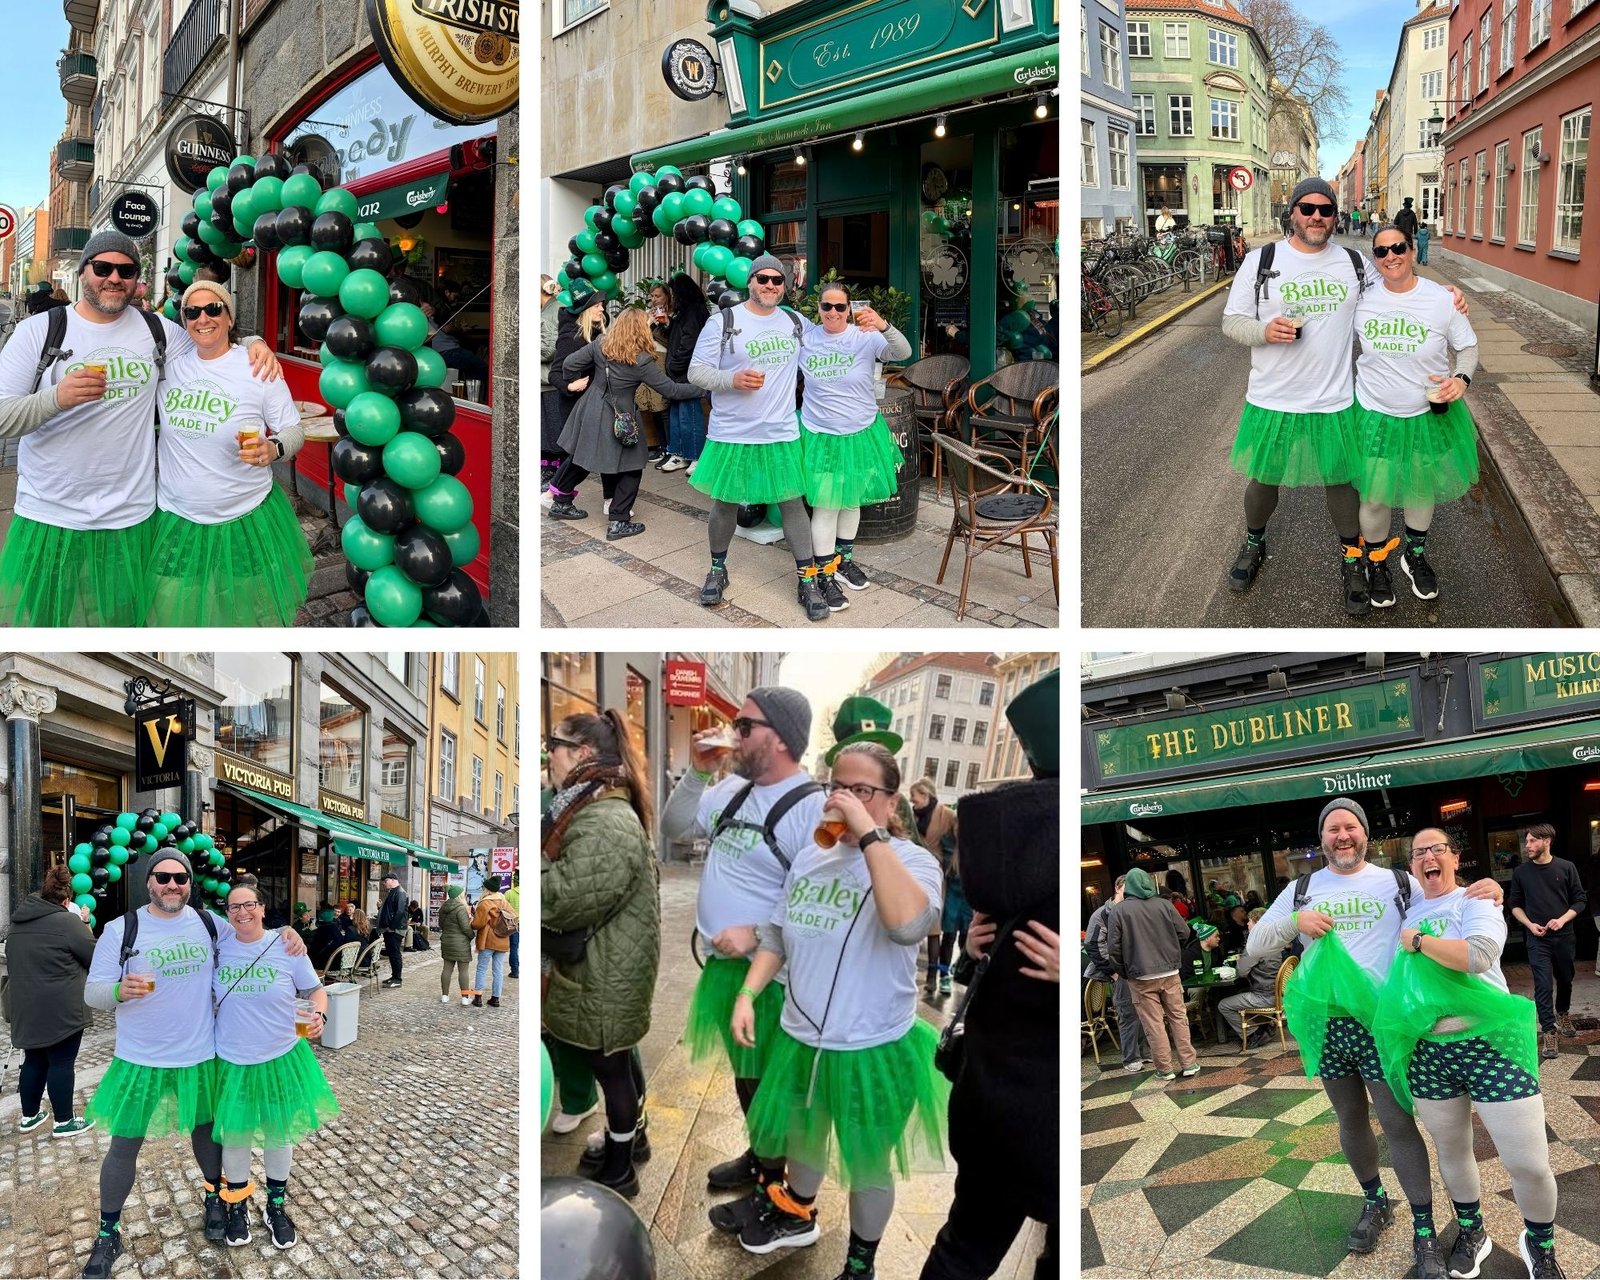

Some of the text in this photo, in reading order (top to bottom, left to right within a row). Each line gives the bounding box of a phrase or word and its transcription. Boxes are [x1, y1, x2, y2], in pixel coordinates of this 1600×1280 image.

[498, 7, 519, 33] ST
[812, 13, 920, 68] Est. 1989
[416, 24, 458, 80] MURPHY
[455, 75, 505, 97] BREWERY
[1013, 60, 1057, 86] Carlsberg
[177, 139, 231, 163] GUINNESS
[125, 201, 146, 211] Face
[406, 186, 437, 208] Carlsberg
[119, 210, 151, 222] Lounge
[1280, 278, 1350, 305] Bailey
[1329, 303, 1339, 313] IT
[1363, 318, 1431, 345] Bailey
[745, 336, 797, 359] Bailey
[1373, 341, 1418, 353] MADE IT
[758, 354, 790, 365] MADE IT
[806, 352, 857, 372] Bailey
[813, 368, 848, 378] MADE IT
[102, 386, 139, 400] ADE IT
[164, 386, 238, 424] Bailey
[168, 415, 218, 433] MADE IT
[1526, 652, 1600, 683] MUSIC
[142, 713, 178, 769] V
[1147, 702, 1354, 760] THE DUBLINER
[141, 771, 181, 785] VICTORIA
[224, 763, 292, 797] VICTORIA PUB
[1322, 772, 1392, 793] Dubliner
[322, 797, 351, 816] VICTORIA
[351, 808, 364, 820] PUB
[1130, 801, 1163, 817] Carlsberg
[357, 846, 390, 861] VICTORIA PUB
[788, 876, 859, 919] Bailey
[1313, 897, 1387, 919] Bailey
[788, 911, 840, 930] MADE IT
[1363, 920, 1374, 930] IT
[145, 943, 209, 969] Bailey
[162, 964, 201, 977] MADE IT
[217, 963, 279, 985] Bailey
[258, 984, 268, 993] IT
